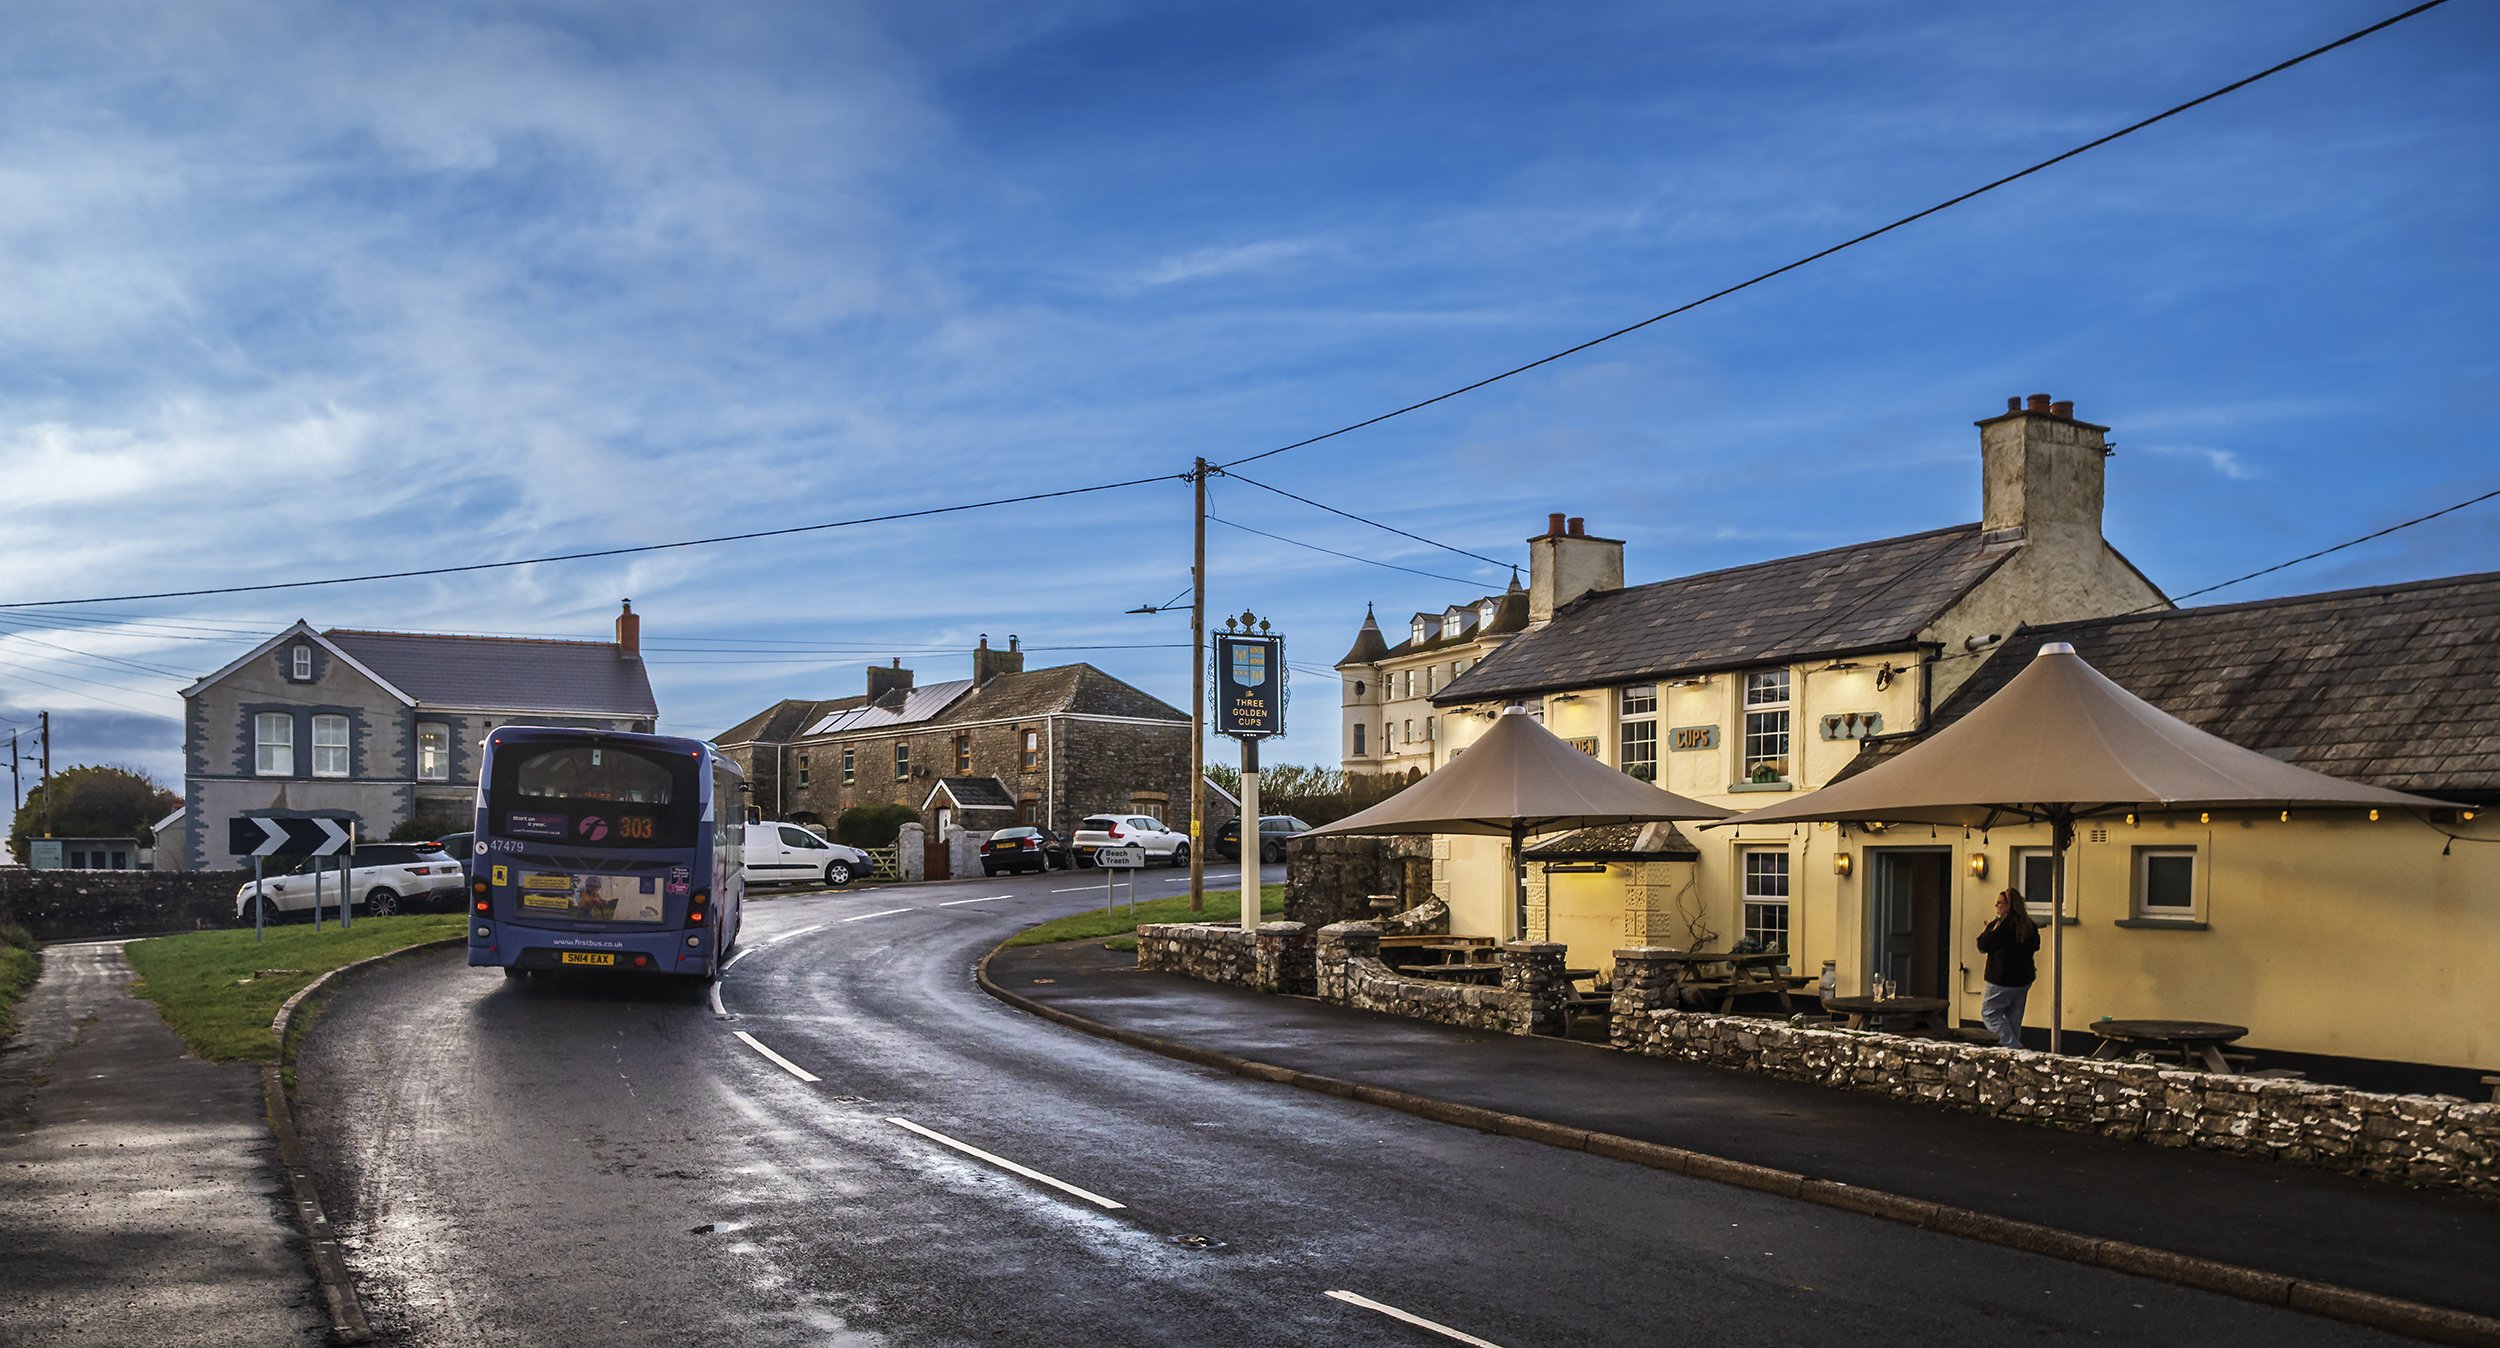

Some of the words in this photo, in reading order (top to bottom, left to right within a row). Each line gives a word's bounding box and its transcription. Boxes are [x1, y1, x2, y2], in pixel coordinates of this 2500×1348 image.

[1236, 698, 1264, 707] THREE
[1232, 708, 1268, 717] GOLDEN
[1238, 718, 1262, 727] CUPS
[1676, 729, 1710, 748] CUPS
[619, 816, 653, 839] 303
[490, 840, 524, 853] 47479
[553, 939, 623, 948] www.firstbus.co.uk
[567, 953, 589, 963] SN14
[590, 954, 609, 964] EAX
